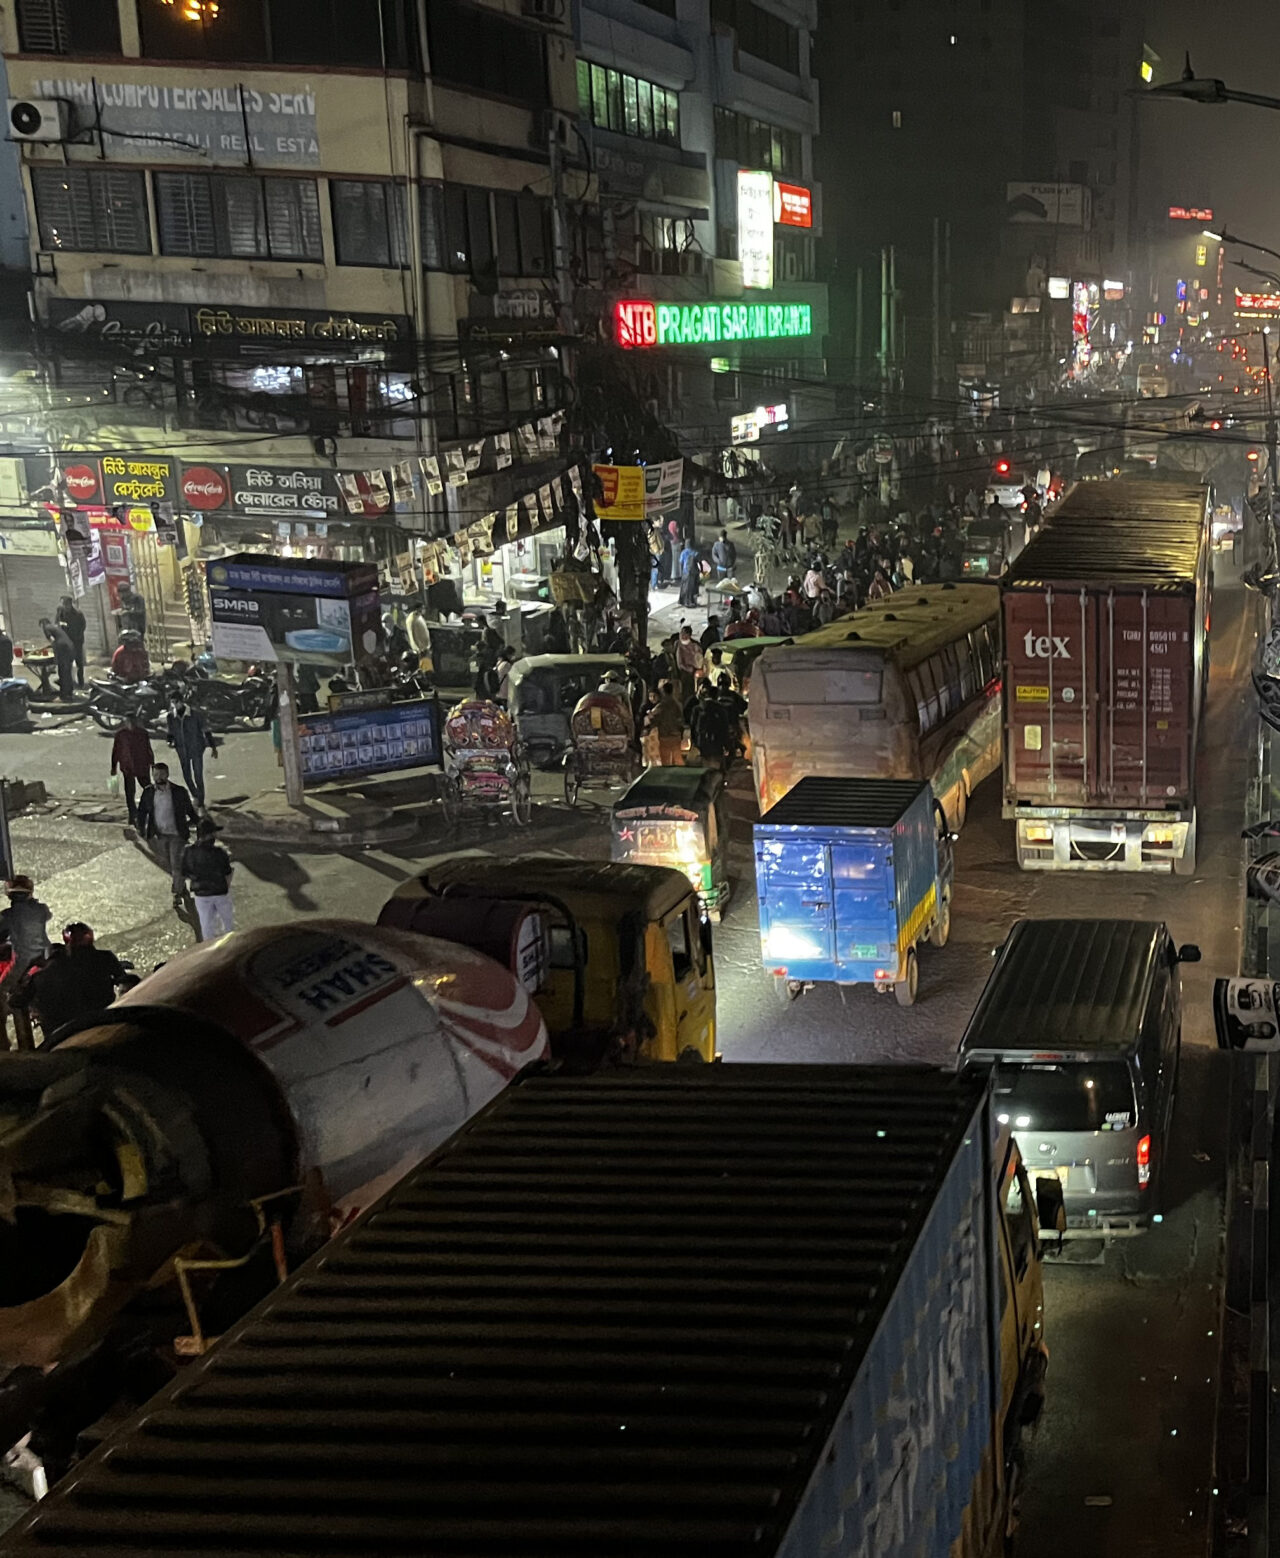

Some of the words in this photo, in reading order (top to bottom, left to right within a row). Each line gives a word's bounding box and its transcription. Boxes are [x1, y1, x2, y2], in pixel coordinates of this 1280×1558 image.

[220, 134, 265, 152] REAL
[657, 305, 721, 344] PRAGATI
[103, 457, 126, 475] নিউ
[246, 468, 274, 487] নিউ
[276, 471, 322, 490] তানিয়া
[235, 491, 298, 507] জেনারেল
[213, 598, 259, 612] SMAB
[1023, 628, 1072, 659] tex
